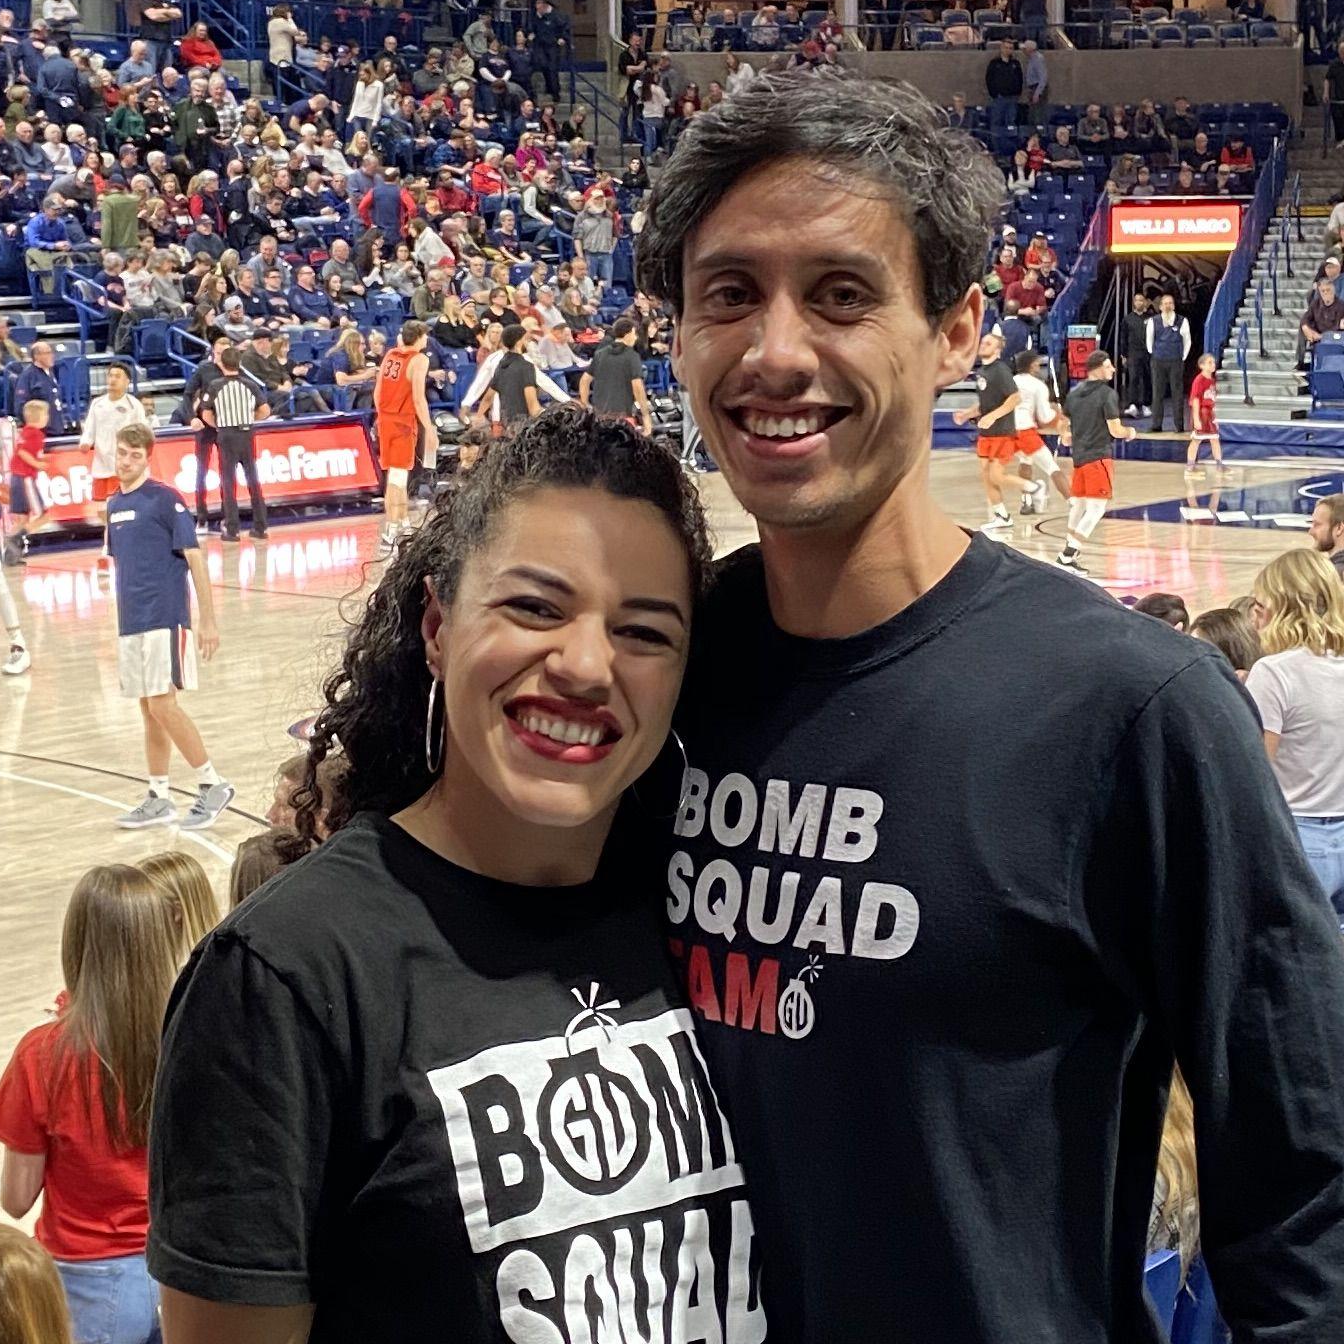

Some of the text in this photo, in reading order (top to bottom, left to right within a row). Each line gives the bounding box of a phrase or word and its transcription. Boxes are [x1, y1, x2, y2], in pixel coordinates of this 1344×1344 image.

[1119, 218, 1232, 235] WELLS FARGO
[383, 358, 401, 379] 33
[673, 767, 886, 863] BOMB
[666, 850, 922, 961] SQUAD
[456, 1024, 739, 1226] BOM
